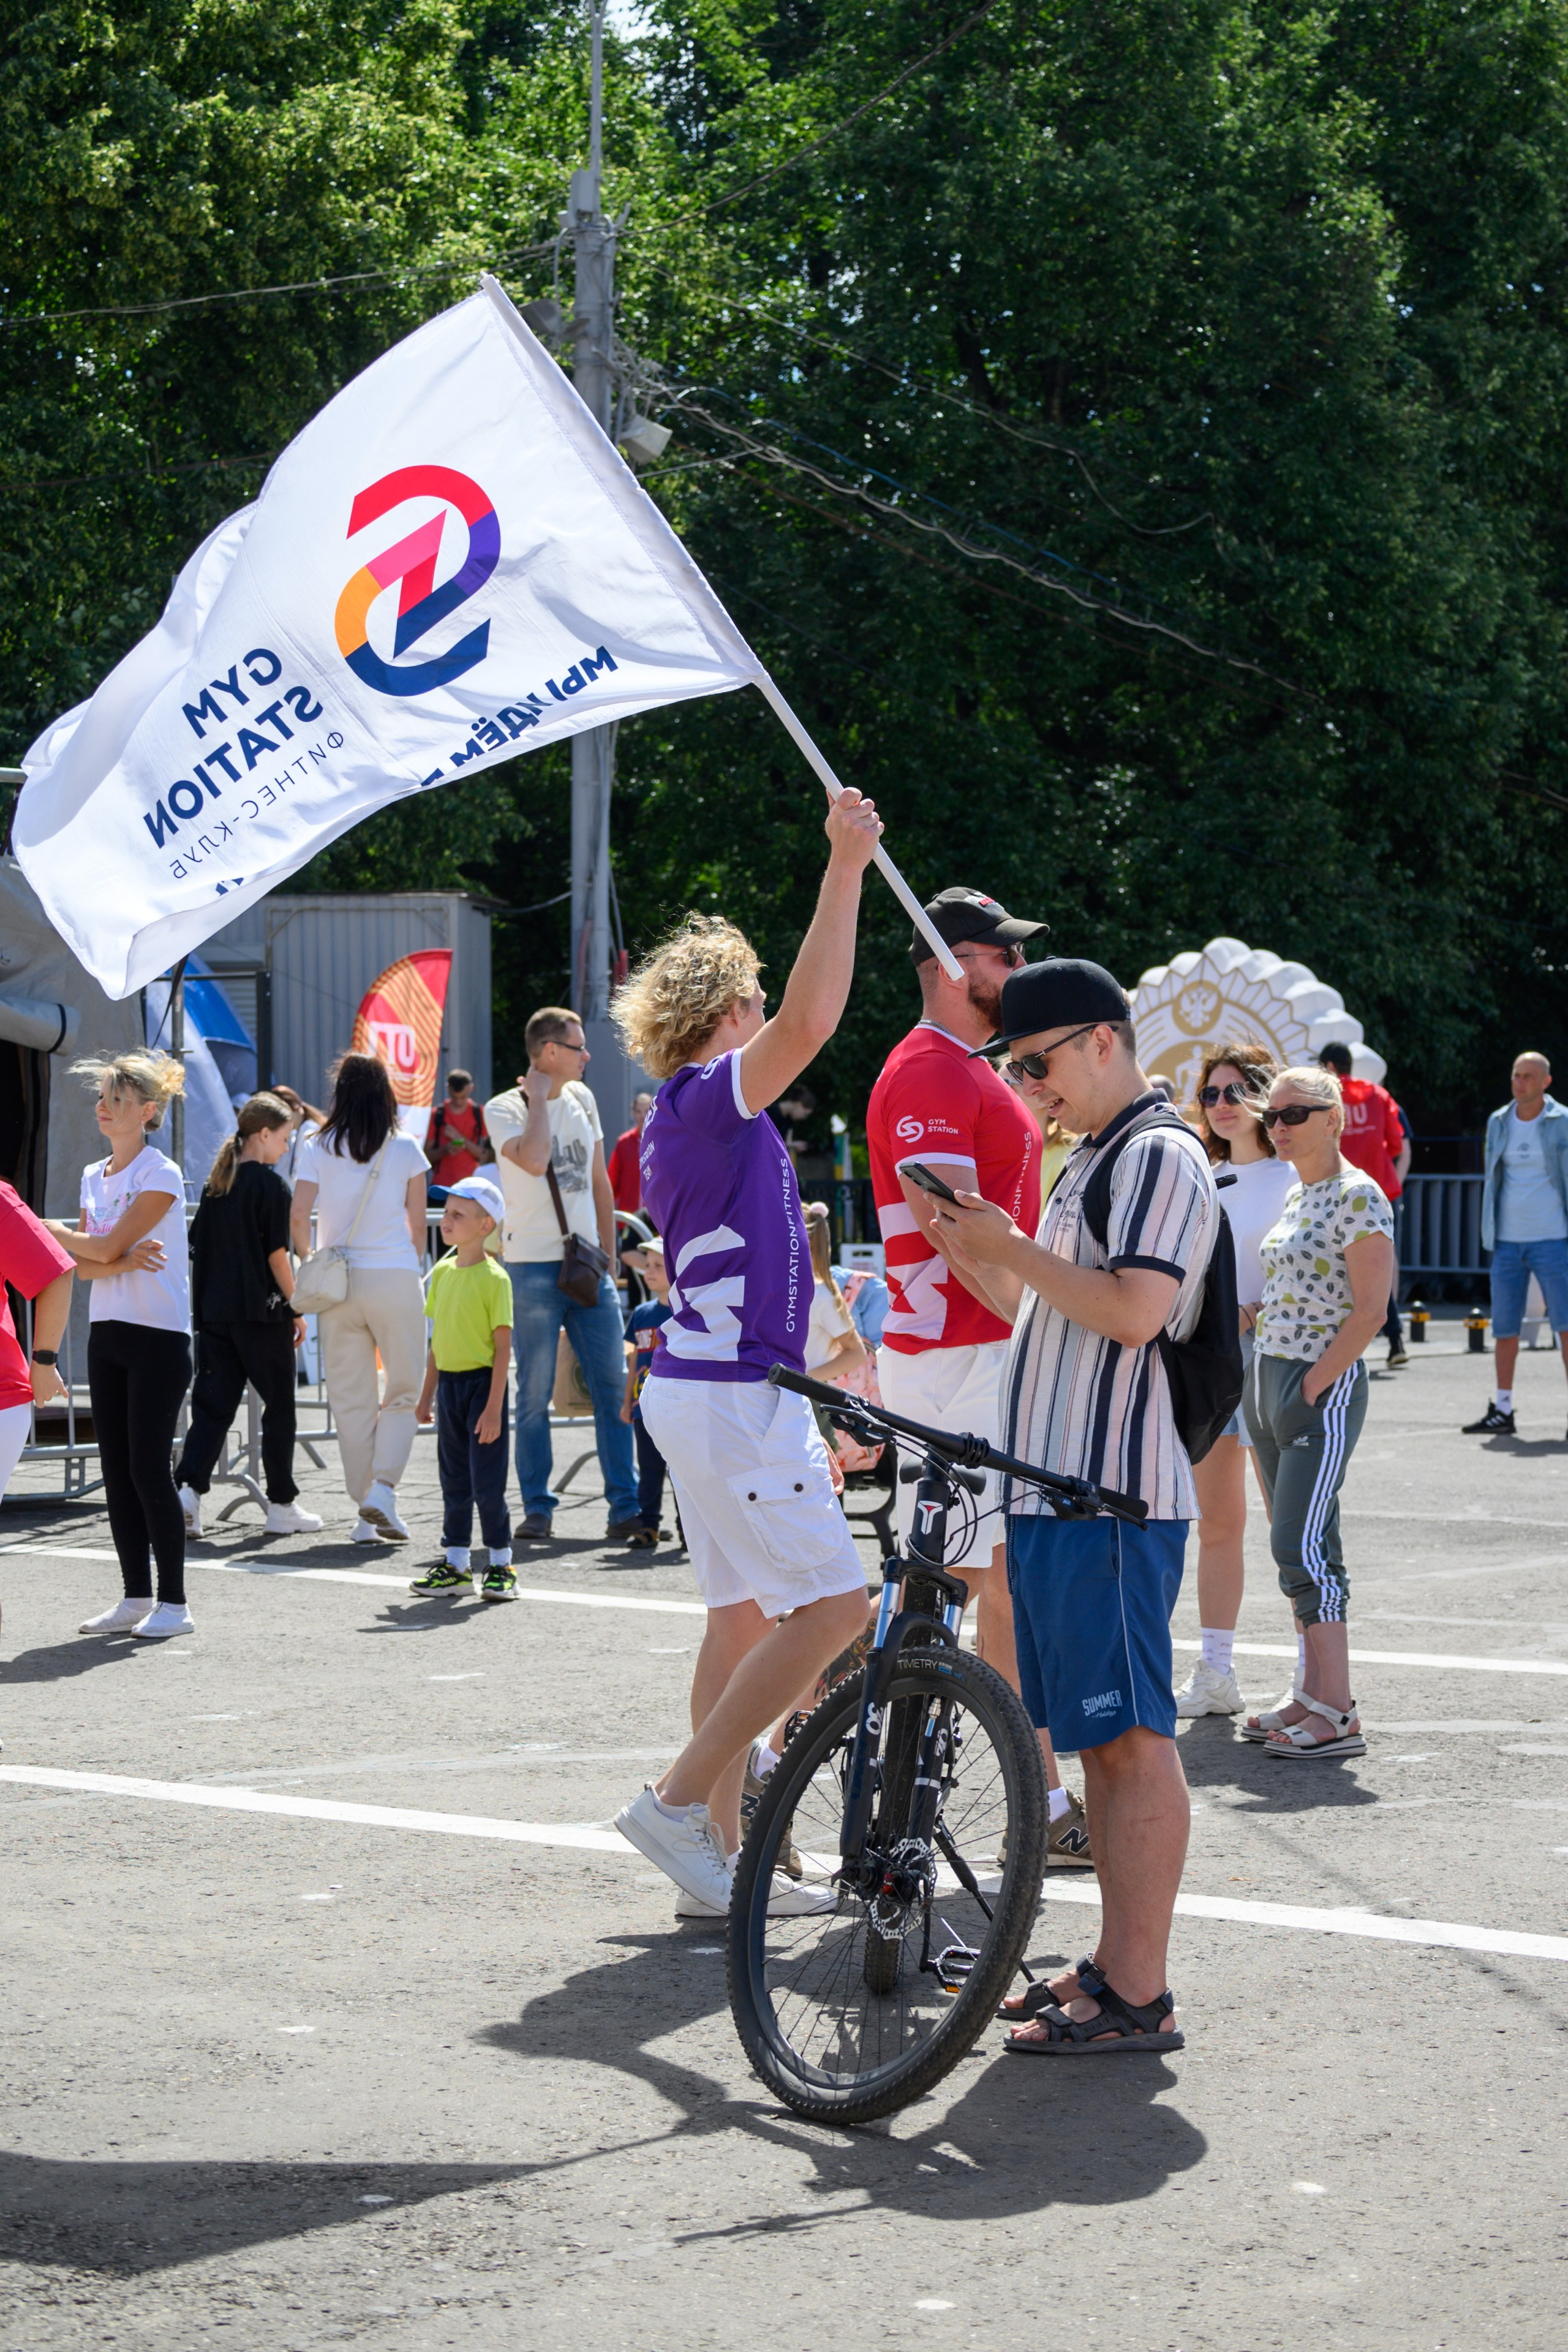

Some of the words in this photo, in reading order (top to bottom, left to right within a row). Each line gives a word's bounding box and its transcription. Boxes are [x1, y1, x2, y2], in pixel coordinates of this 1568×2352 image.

[927, 1126, 959, 1134] STATION
[781, 1158, 799, 1333] GYMSTATIONFITNESS
[1082, 1690, 1123, 1716] SUMMER
